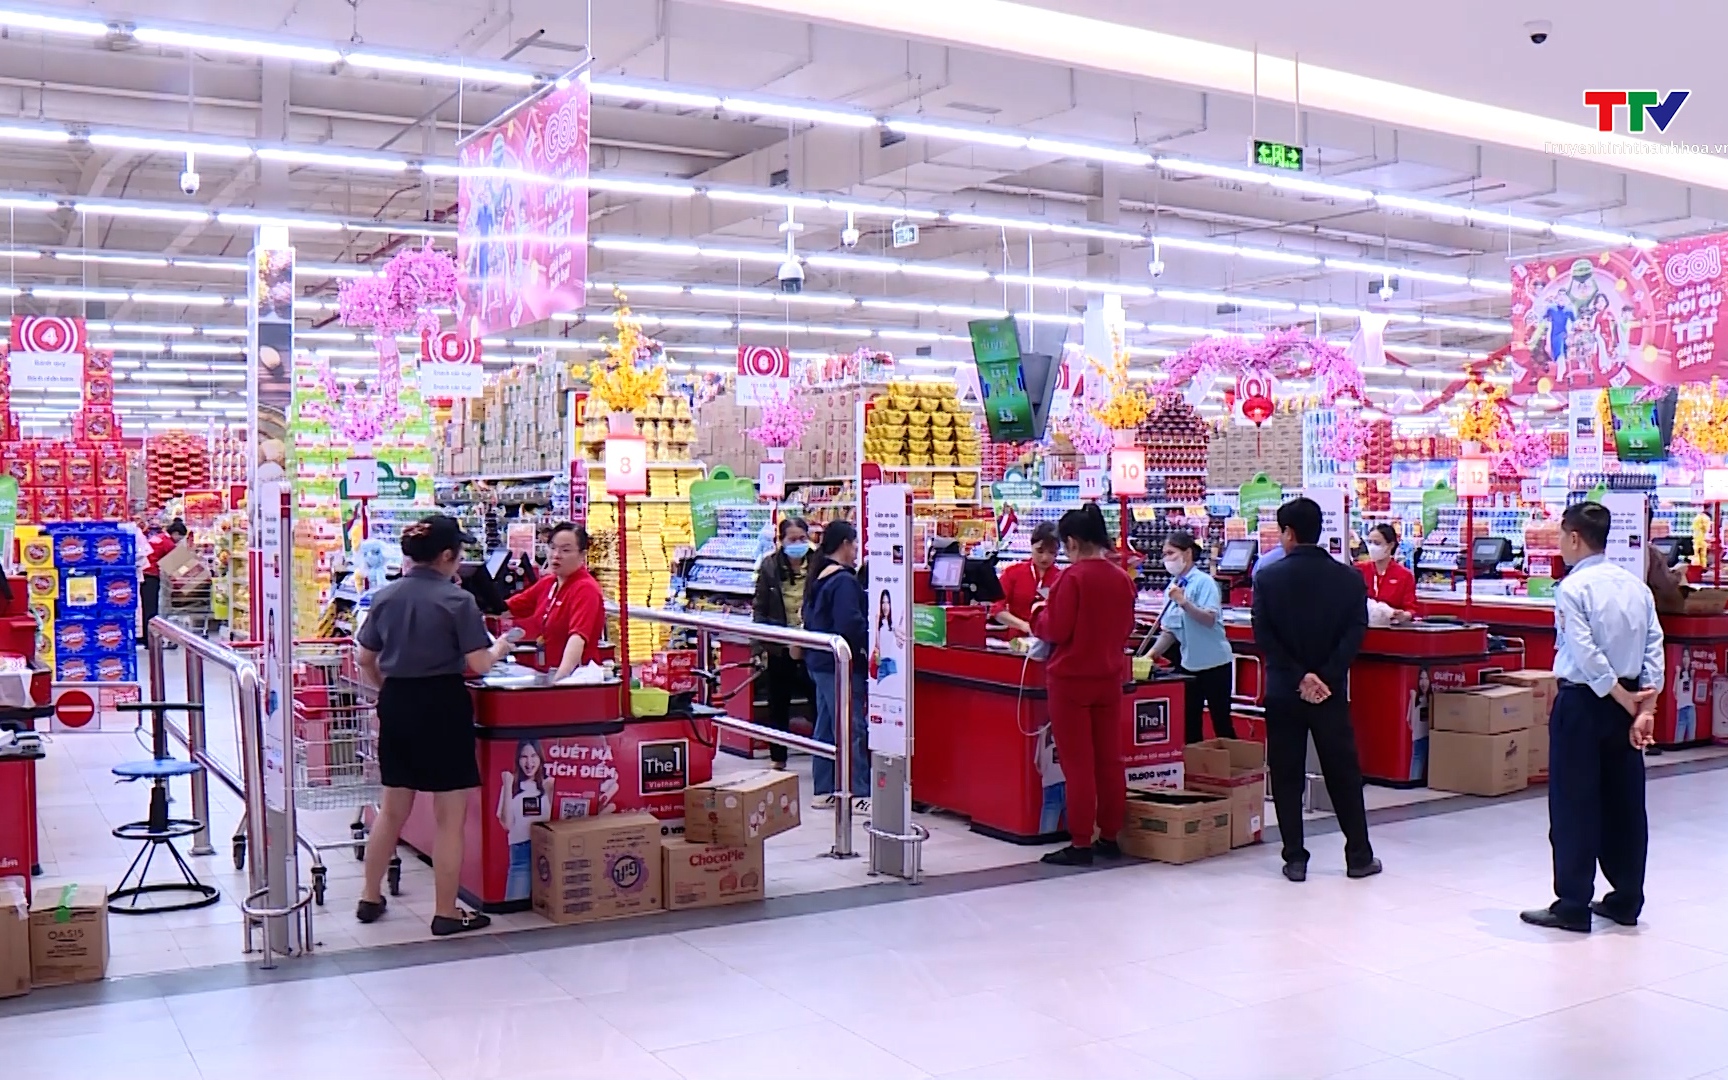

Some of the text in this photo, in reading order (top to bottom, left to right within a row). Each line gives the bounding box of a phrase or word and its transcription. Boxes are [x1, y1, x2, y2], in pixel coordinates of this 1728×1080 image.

[544, 96, 578, 162] GO!
[1664, 245, 1722, 286] GO!
[1667, 296, 1696, 317] MỌI
[40, 326, 58, 346] 4
[1672, 310, 1718, 344] TẾT
[619, 457, 632, 475] 8
[1121, 464, 1140, 479] 10
[353, 470, 360, 484] 7
[767, 473, 775, 485] 9
[1085, 477, 1096, 488] 11
[1471, 471, 1484, 484] 12
[549, 743, 613, 761] QUÉT MÃ
[543, 760, 616, 778] TÍCH ĐIỂM
[689, 849, 745, 867] ChocoPie
[47, 929, 84, 940] OASIS
